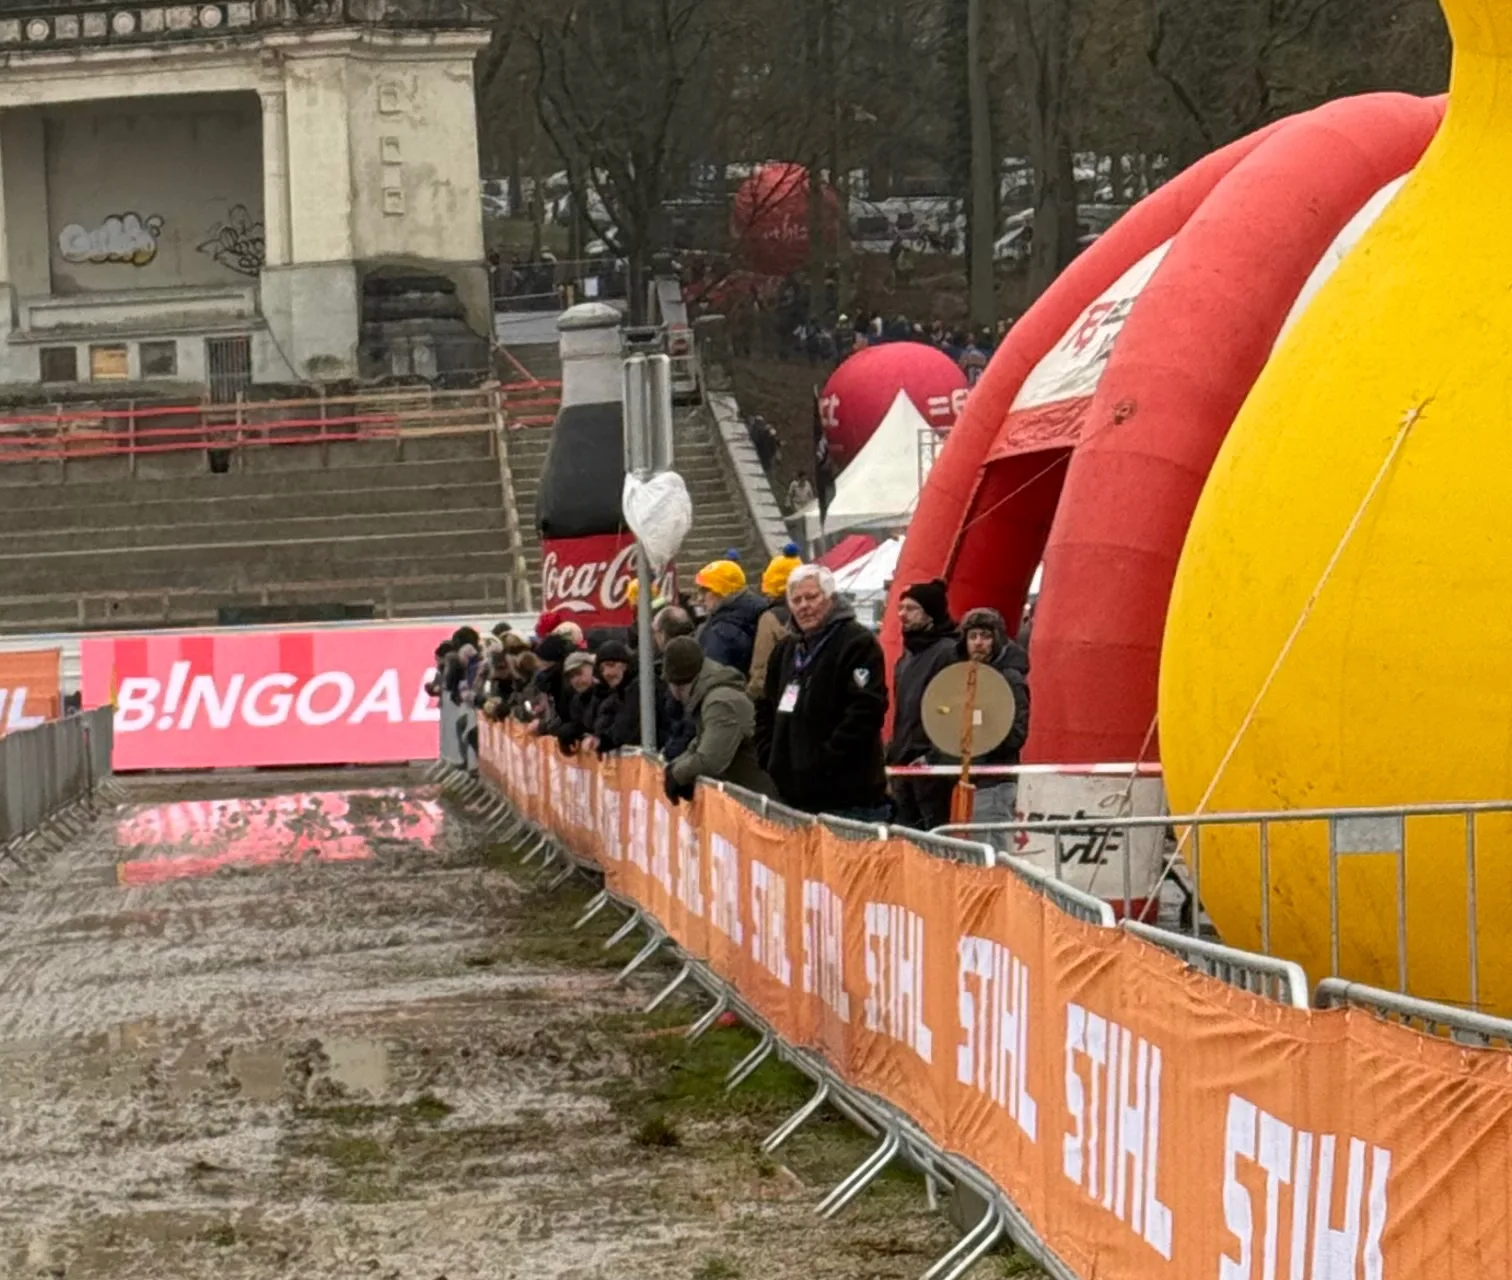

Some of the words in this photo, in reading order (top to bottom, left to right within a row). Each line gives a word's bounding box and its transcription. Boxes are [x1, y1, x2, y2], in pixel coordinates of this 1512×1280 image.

[864, 901, 932, 1065] STIHL
[956, 934, 1037, 1144] STIHL
[1064, 1002, 1173, 1262] STIHL
